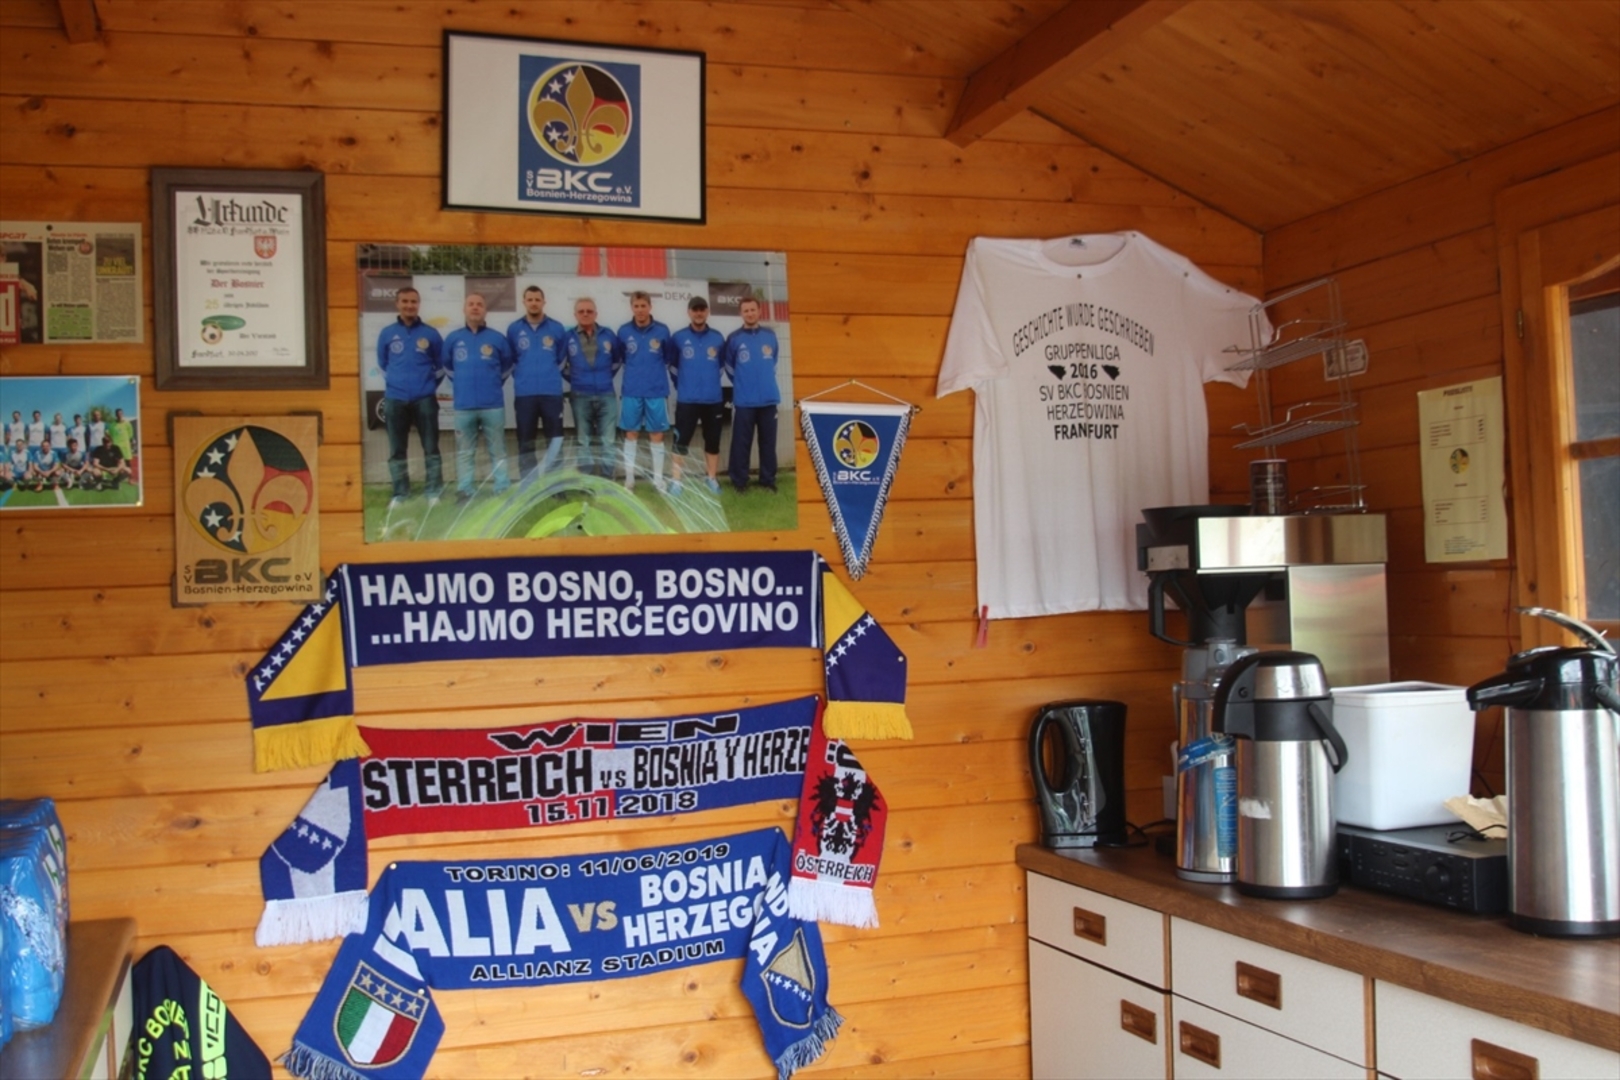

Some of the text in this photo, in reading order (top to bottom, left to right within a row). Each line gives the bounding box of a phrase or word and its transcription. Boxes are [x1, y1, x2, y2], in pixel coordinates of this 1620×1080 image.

[526, 188, 632, 203] Bosnien-Herzegowina
[537, 168, 613, 193] BKC
[193, 195, 288, 226] Urkunde
[1013, 303, 1155, 357] GESCHICHTE WURDE GESCHRIEBEN
[1044, 343, 1121, 361] GRUPPENLIGA
[1070, 362, 1098, 379] 2016
[1039, 385, 1054, 401] SV
[1058, 382, 1082, 400] BKC
[1047, 402, 1125, 421] HERZEOWINA
[837, 470, 871, 481] BKC
[194, 557, 292, 584] BKC
[360, 566, 803, 607] HAJMO BOSNO, BOSNO...
[184, 583, 313, 596] Bosnien-Herzegowina
[371, 608, 534, 645] ...HAJMO
[487, 713, 740, 752] WIEN
[631, 739, 719, 790] BOSNIA
[724, 735, 741, 780] Y
[524, 791, 697, 824] 15.11.2018
[444, 843, 730, 882] TORINO: 11/06/2019
[795, 849, 875, 884] ÖSTERREICH
[640, 855, 767, 908] BOSNIA
[567, 900, 618, 933] VS
[470, 939, 725, 981] ALLIANZ STADIUM
